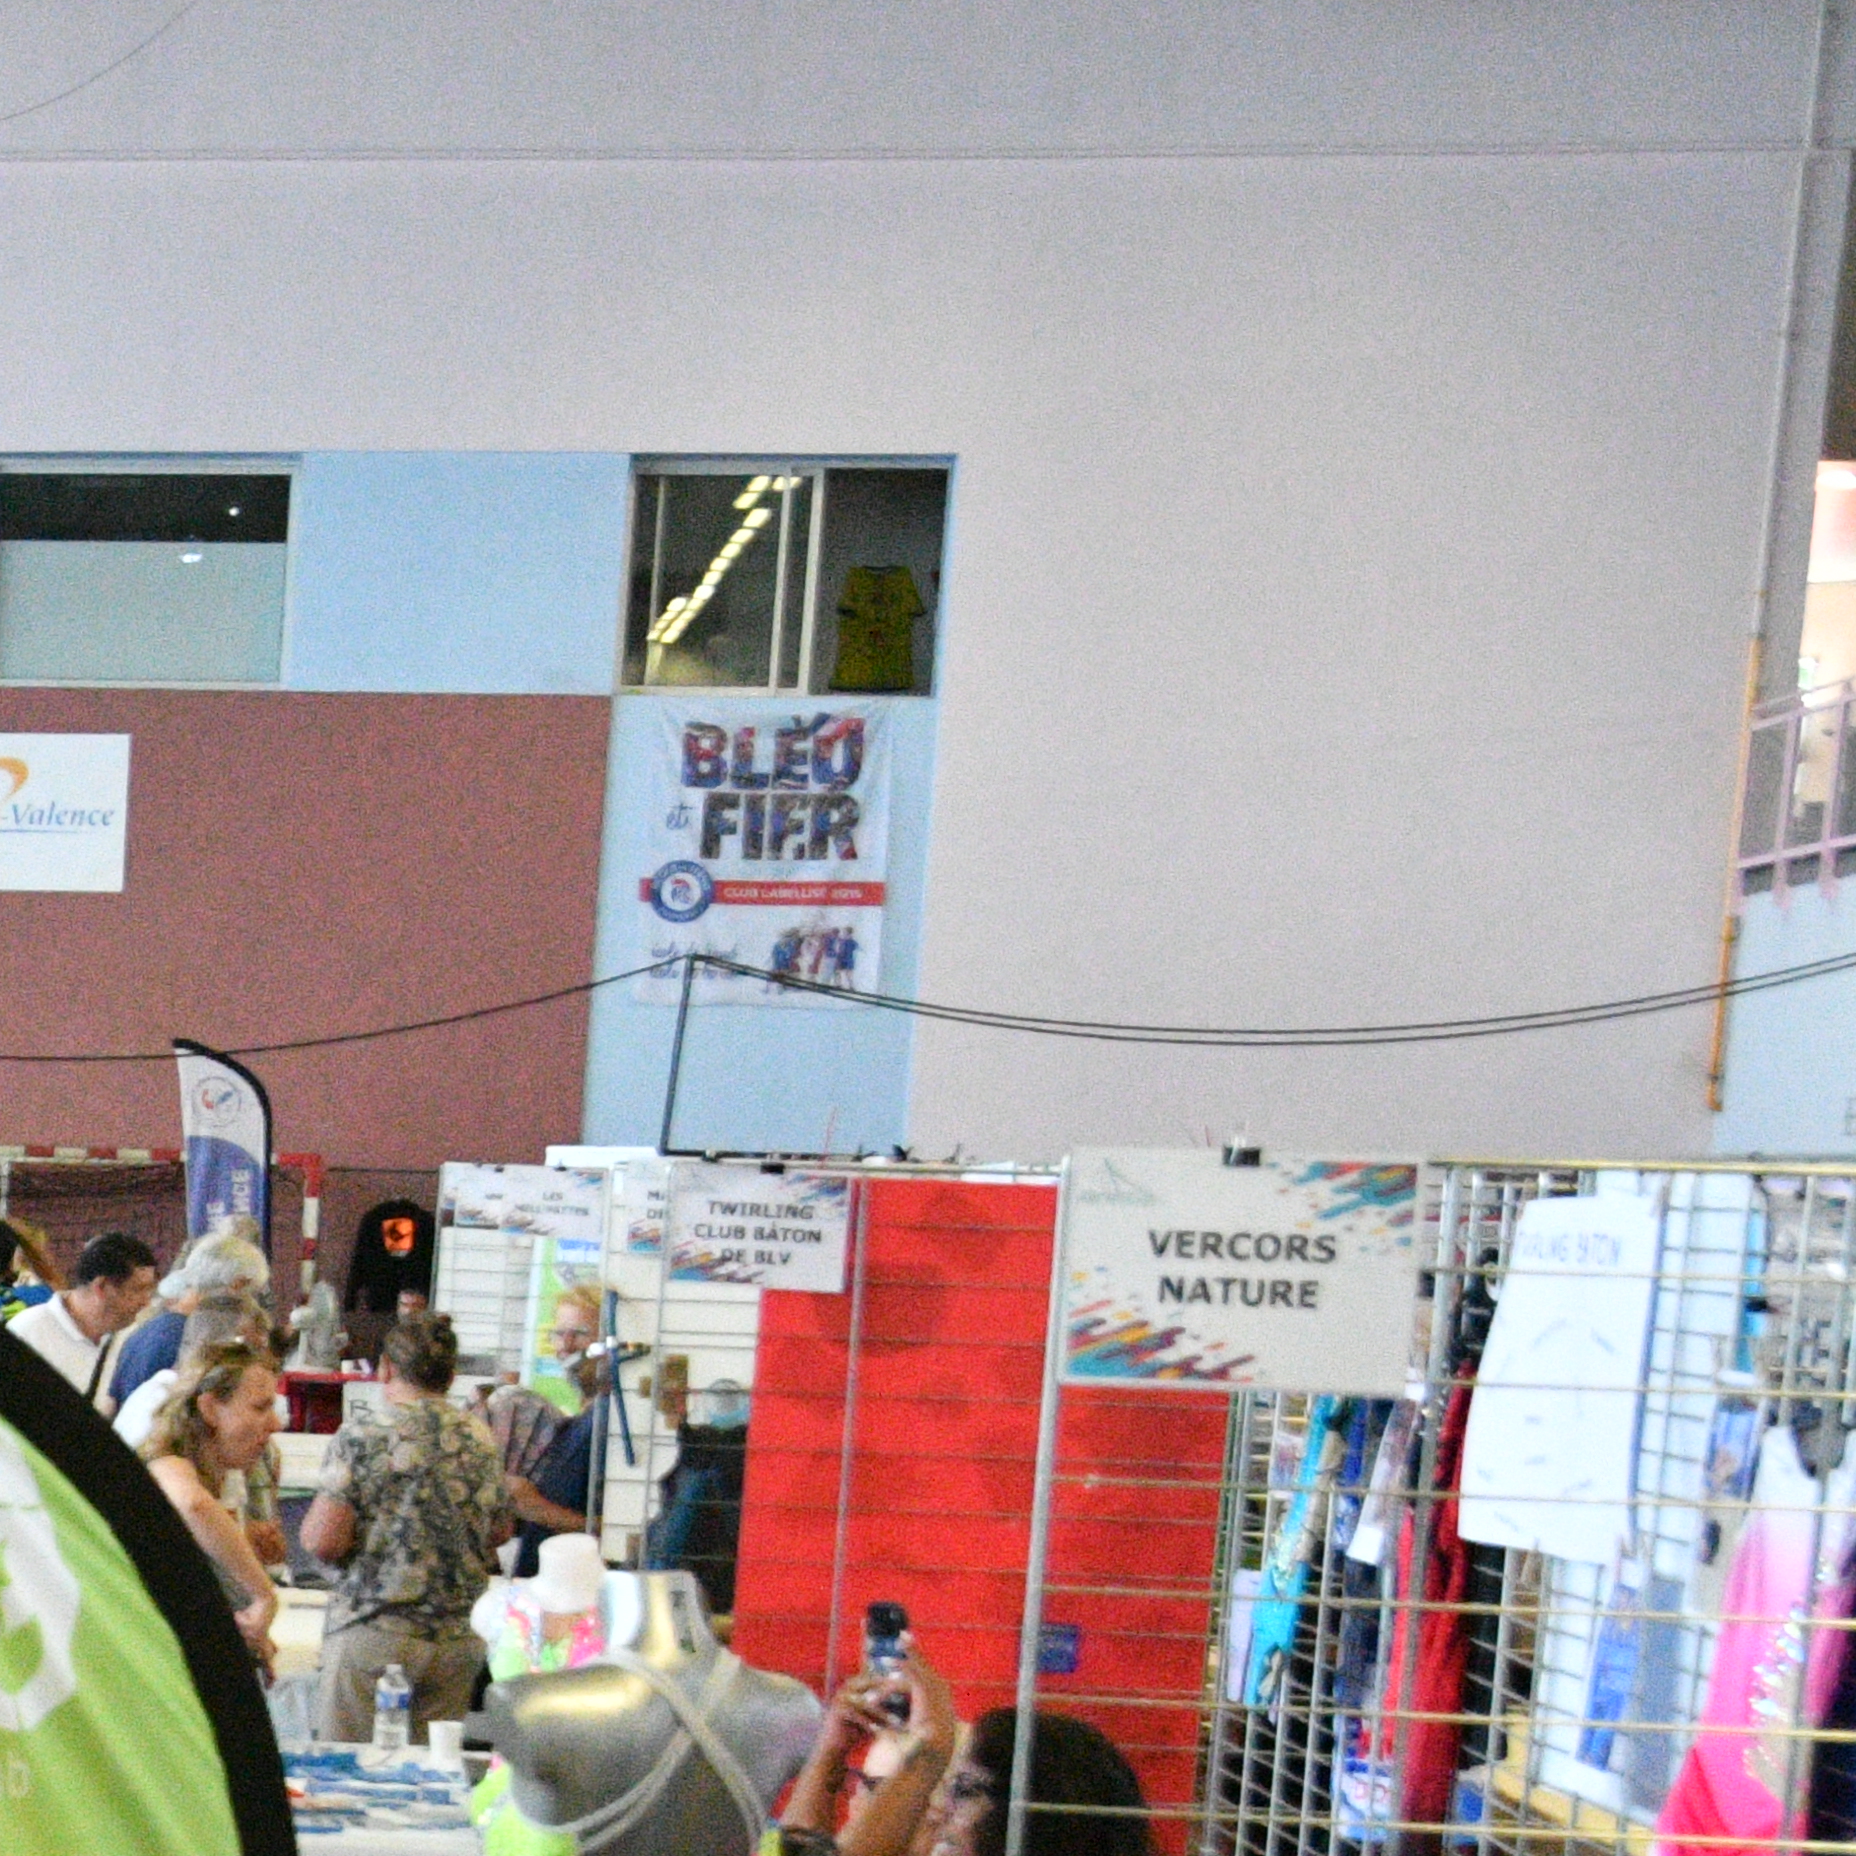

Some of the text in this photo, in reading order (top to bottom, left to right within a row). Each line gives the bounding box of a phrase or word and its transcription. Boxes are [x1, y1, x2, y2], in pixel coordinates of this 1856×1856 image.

[708, 1200, 815, 1221] TWIRLING
[693, 1223, 745, 1243] CLUB
[1149, 1229, 1337, 1265] VERCORS
[1158, 1275, 1320, 1310] NATURE
